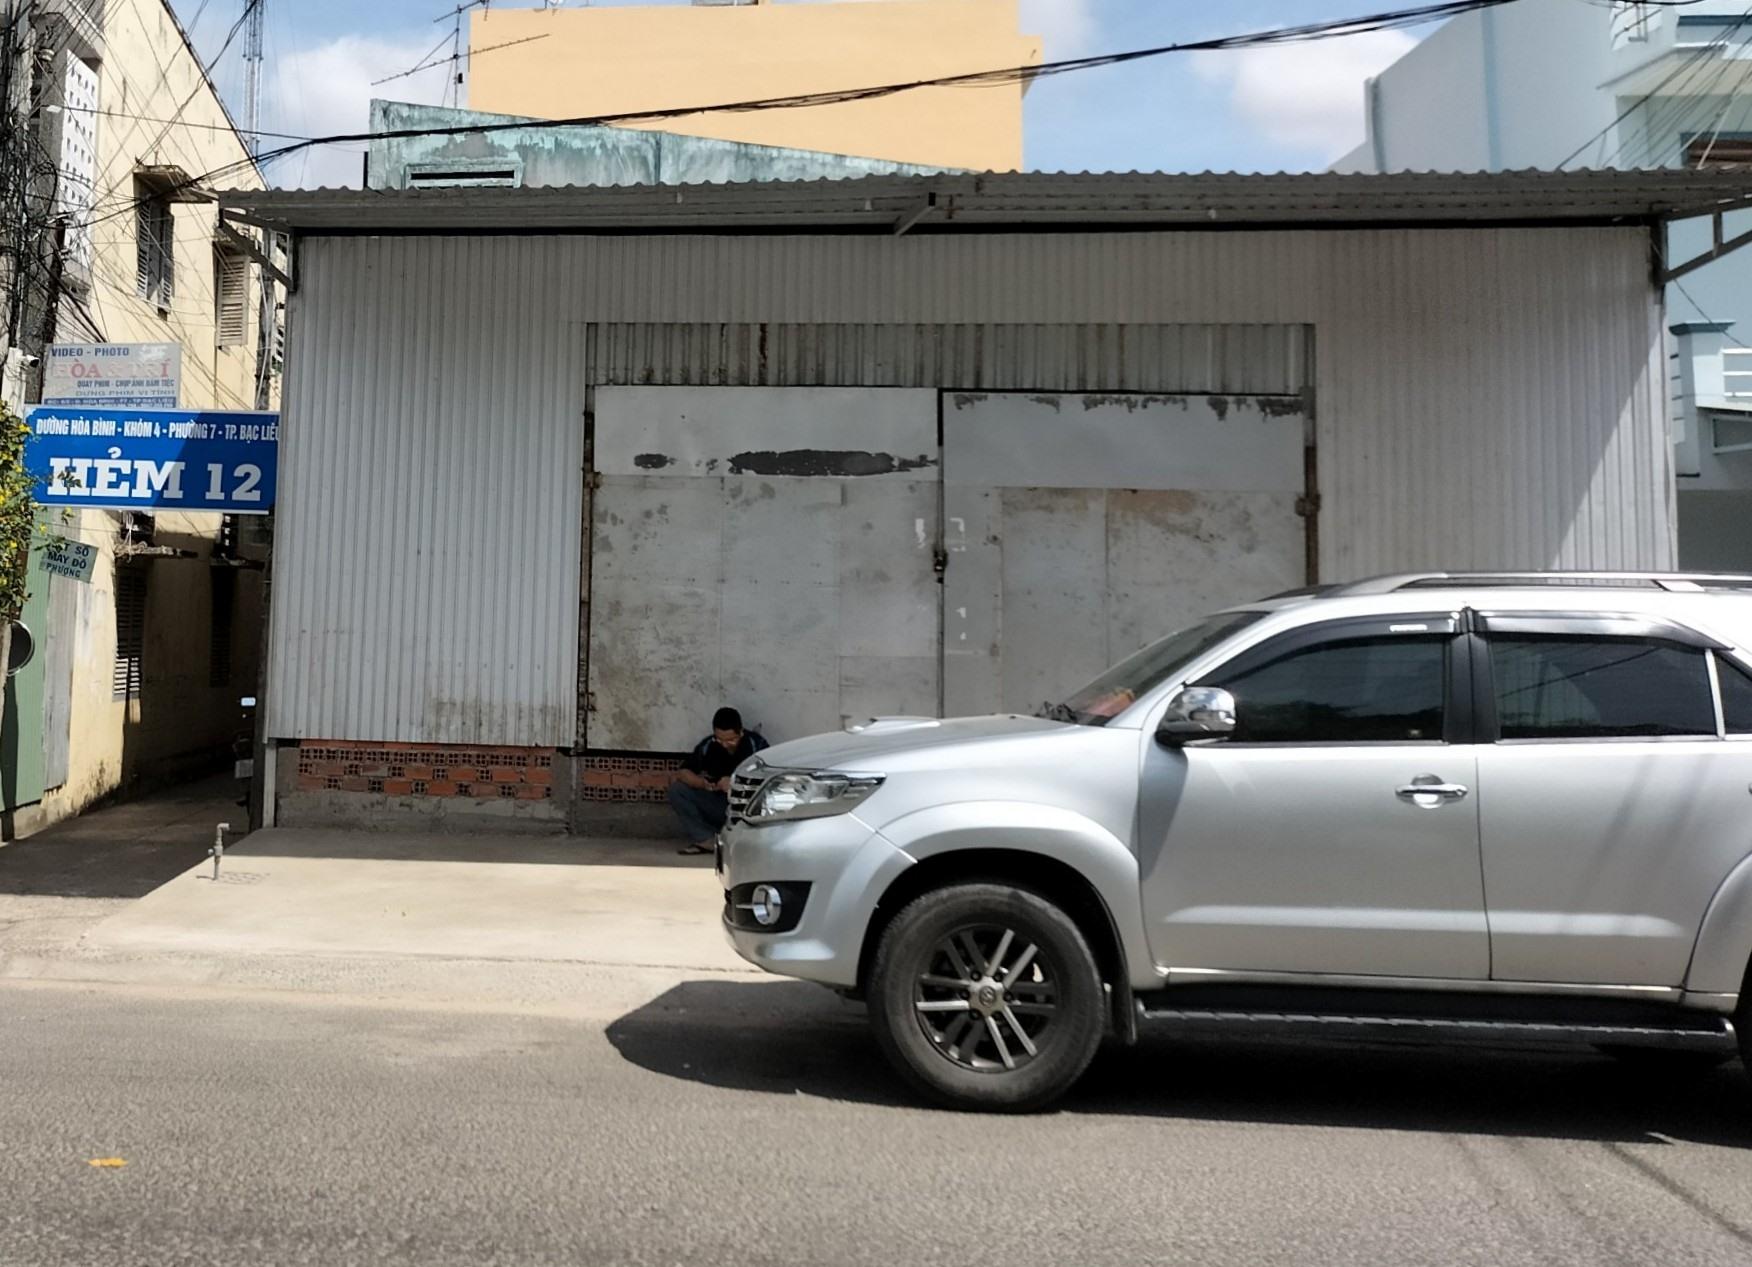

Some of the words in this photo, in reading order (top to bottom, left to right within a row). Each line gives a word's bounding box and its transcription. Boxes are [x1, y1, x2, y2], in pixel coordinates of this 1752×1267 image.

[51, 347, 83, 357] VIDEO
[94, 347, 130, 357] PHOTO
[35, 415, 70, 435] ĐƯỜNG
[92, 417, 116, 437] BÌNH
[123, 418, 153, 438] KHÓM
[153, 422, 161, 439] 4
[168, 419, 208, 440] PHƯỜNG
[209, 424, 217, 440] 7
[224, 424, 238, 440] TP.
[239, 424, 260, 444] BẠC
[47, 446, 186, 499] HẺM
[205, 463, 262, 501] 12
[47, 551, 70, 564] MAY
